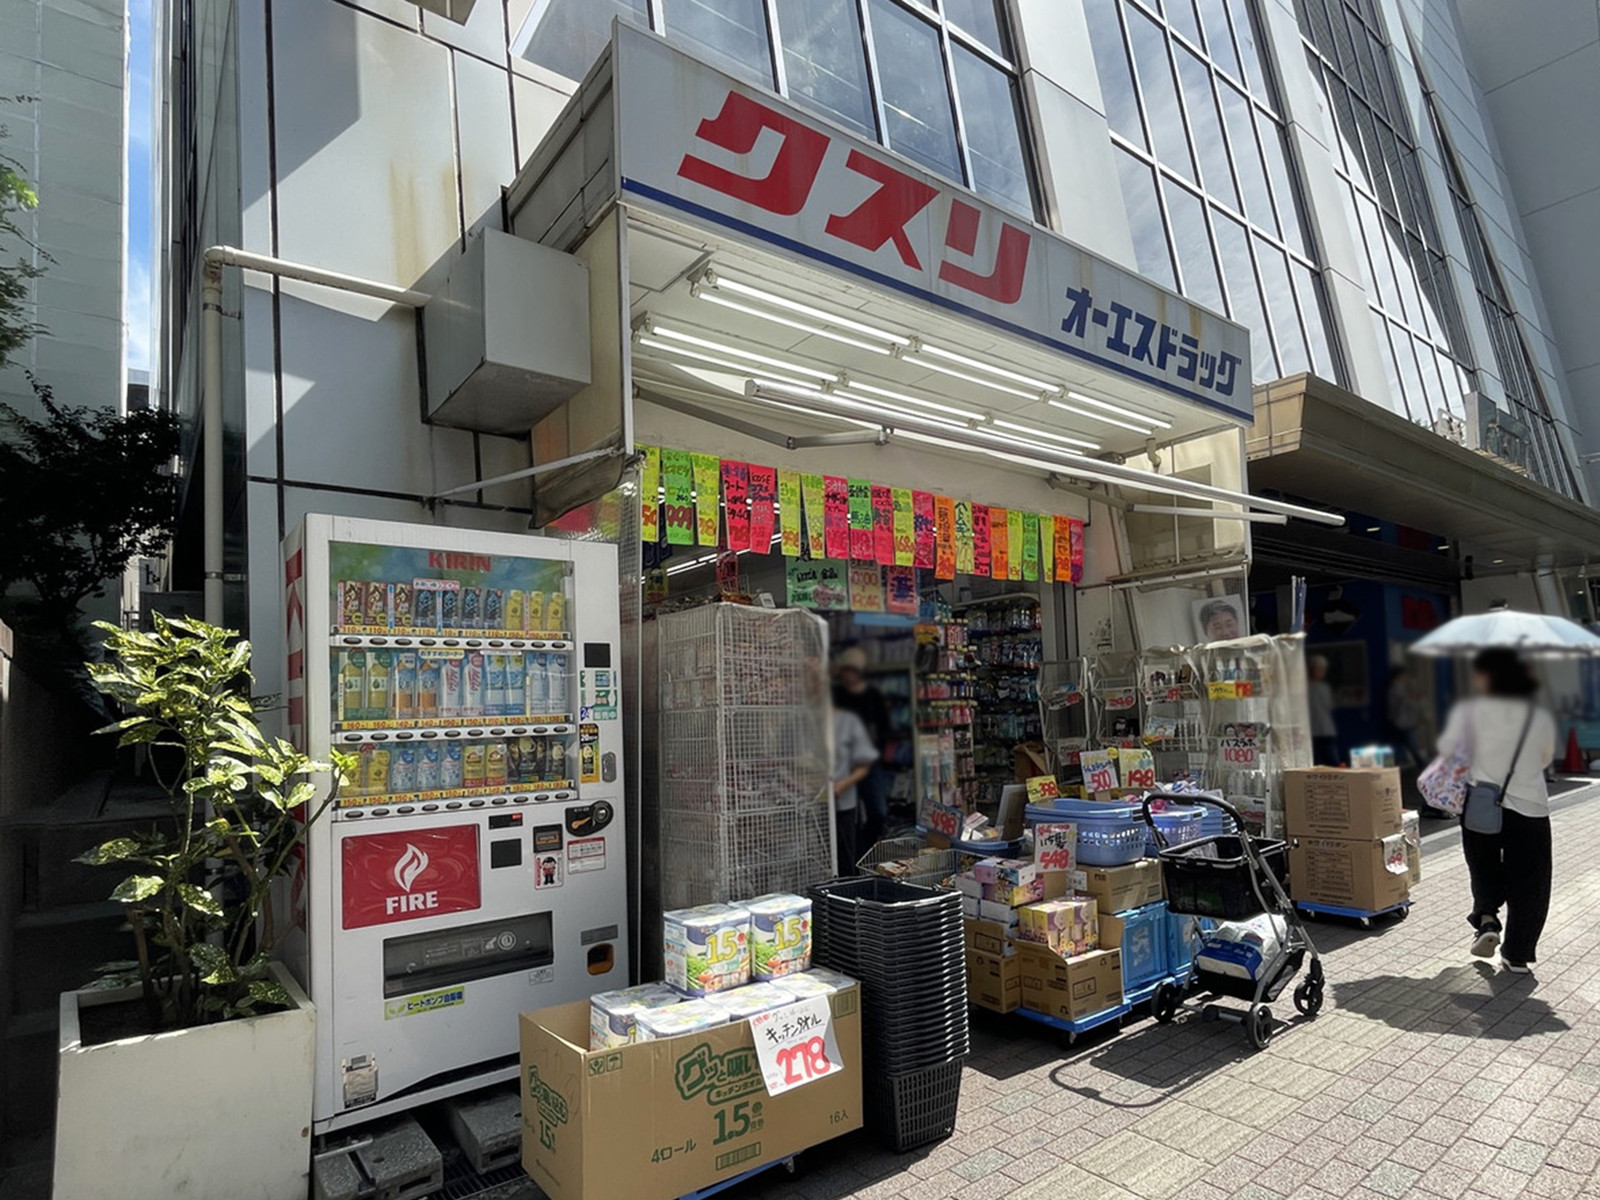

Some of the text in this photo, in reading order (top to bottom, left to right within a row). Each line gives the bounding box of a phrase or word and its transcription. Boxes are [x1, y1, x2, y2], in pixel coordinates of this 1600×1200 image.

[678, 91, 1031, 304] クスリ
[1061, 287, 1242, 396] オーエスドラッグ
[428, 552, 491, 572] KIRIN
[1127, 769, 1154, 788] 198
[386, 891, 439, 915] FIRE
[776, 1036, 831, 1086] 278
[713, 1101, 750, 1146] 1.5
[829, 1109, 849, 1125] 16入
[651, 1139, 697, 1164] 4ロール
